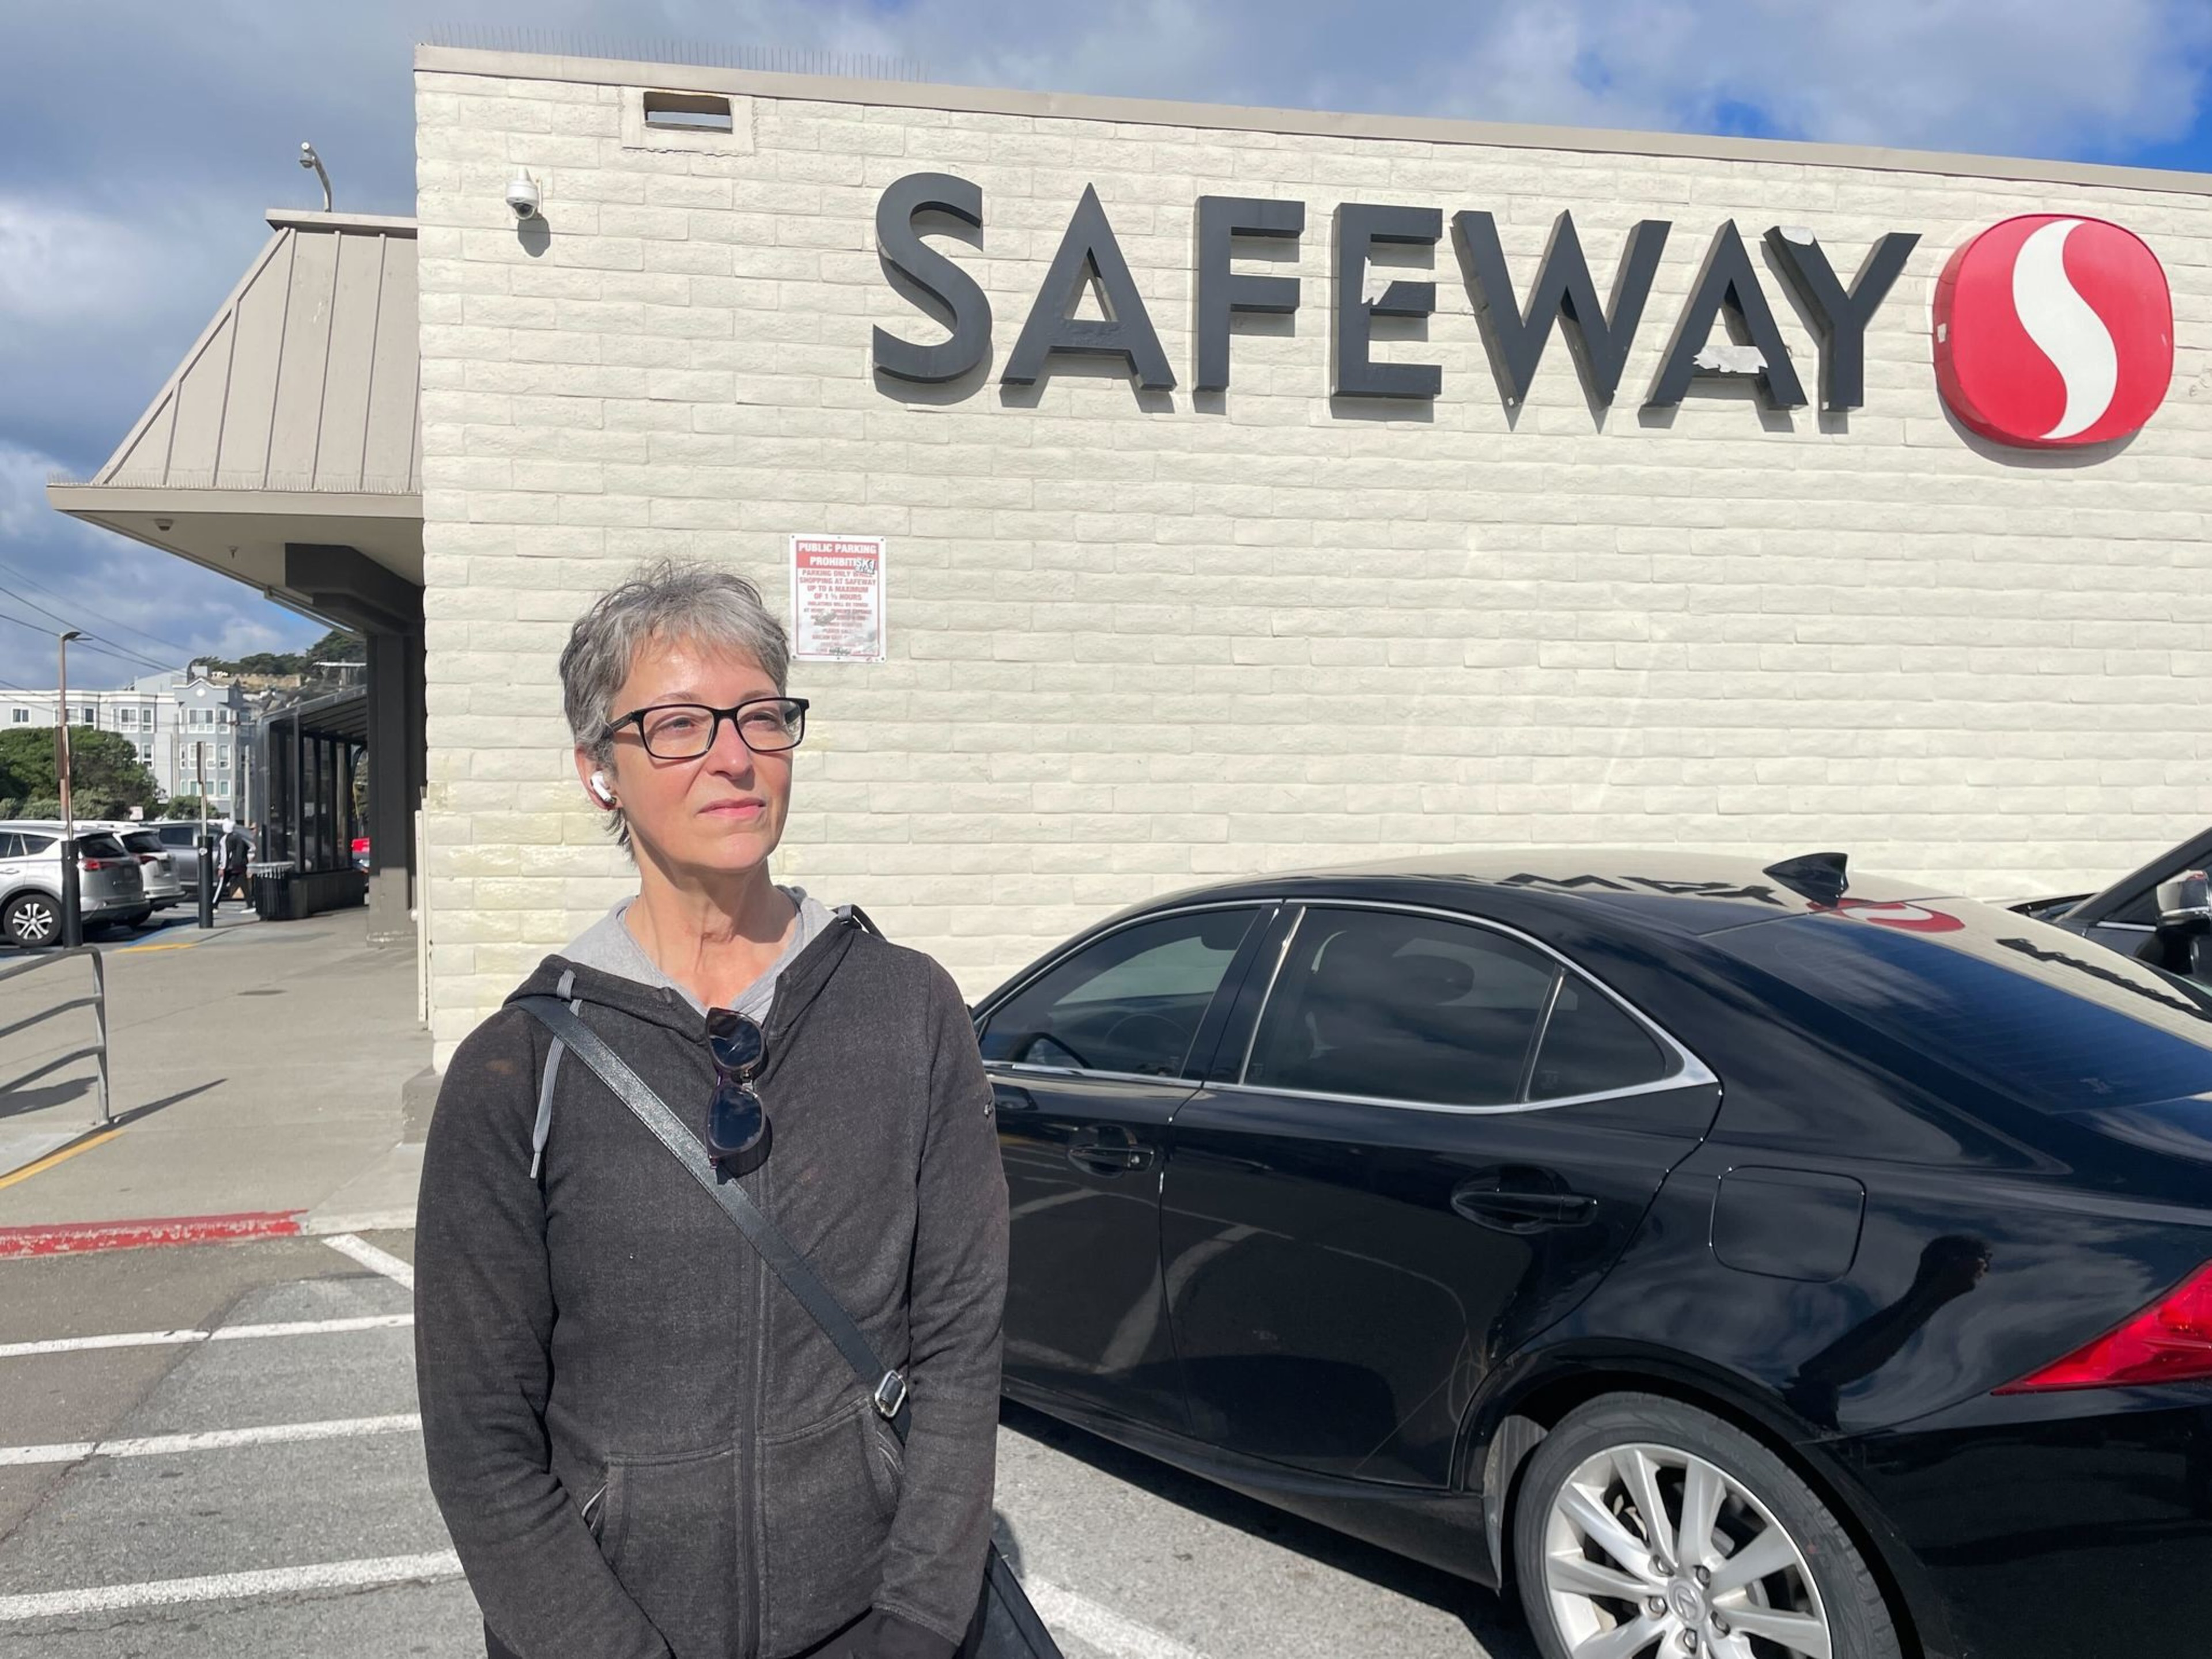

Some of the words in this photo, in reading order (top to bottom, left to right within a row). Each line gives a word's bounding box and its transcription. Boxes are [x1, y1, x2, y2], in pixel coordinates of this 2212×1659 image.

[872, 172, 1922, 410] SAFEWAY
[799, 542, 833, 552] PUBLIC
[835, 543, 877, 554] PARKING
[810, 556, 868, 567] PROHIBIT
